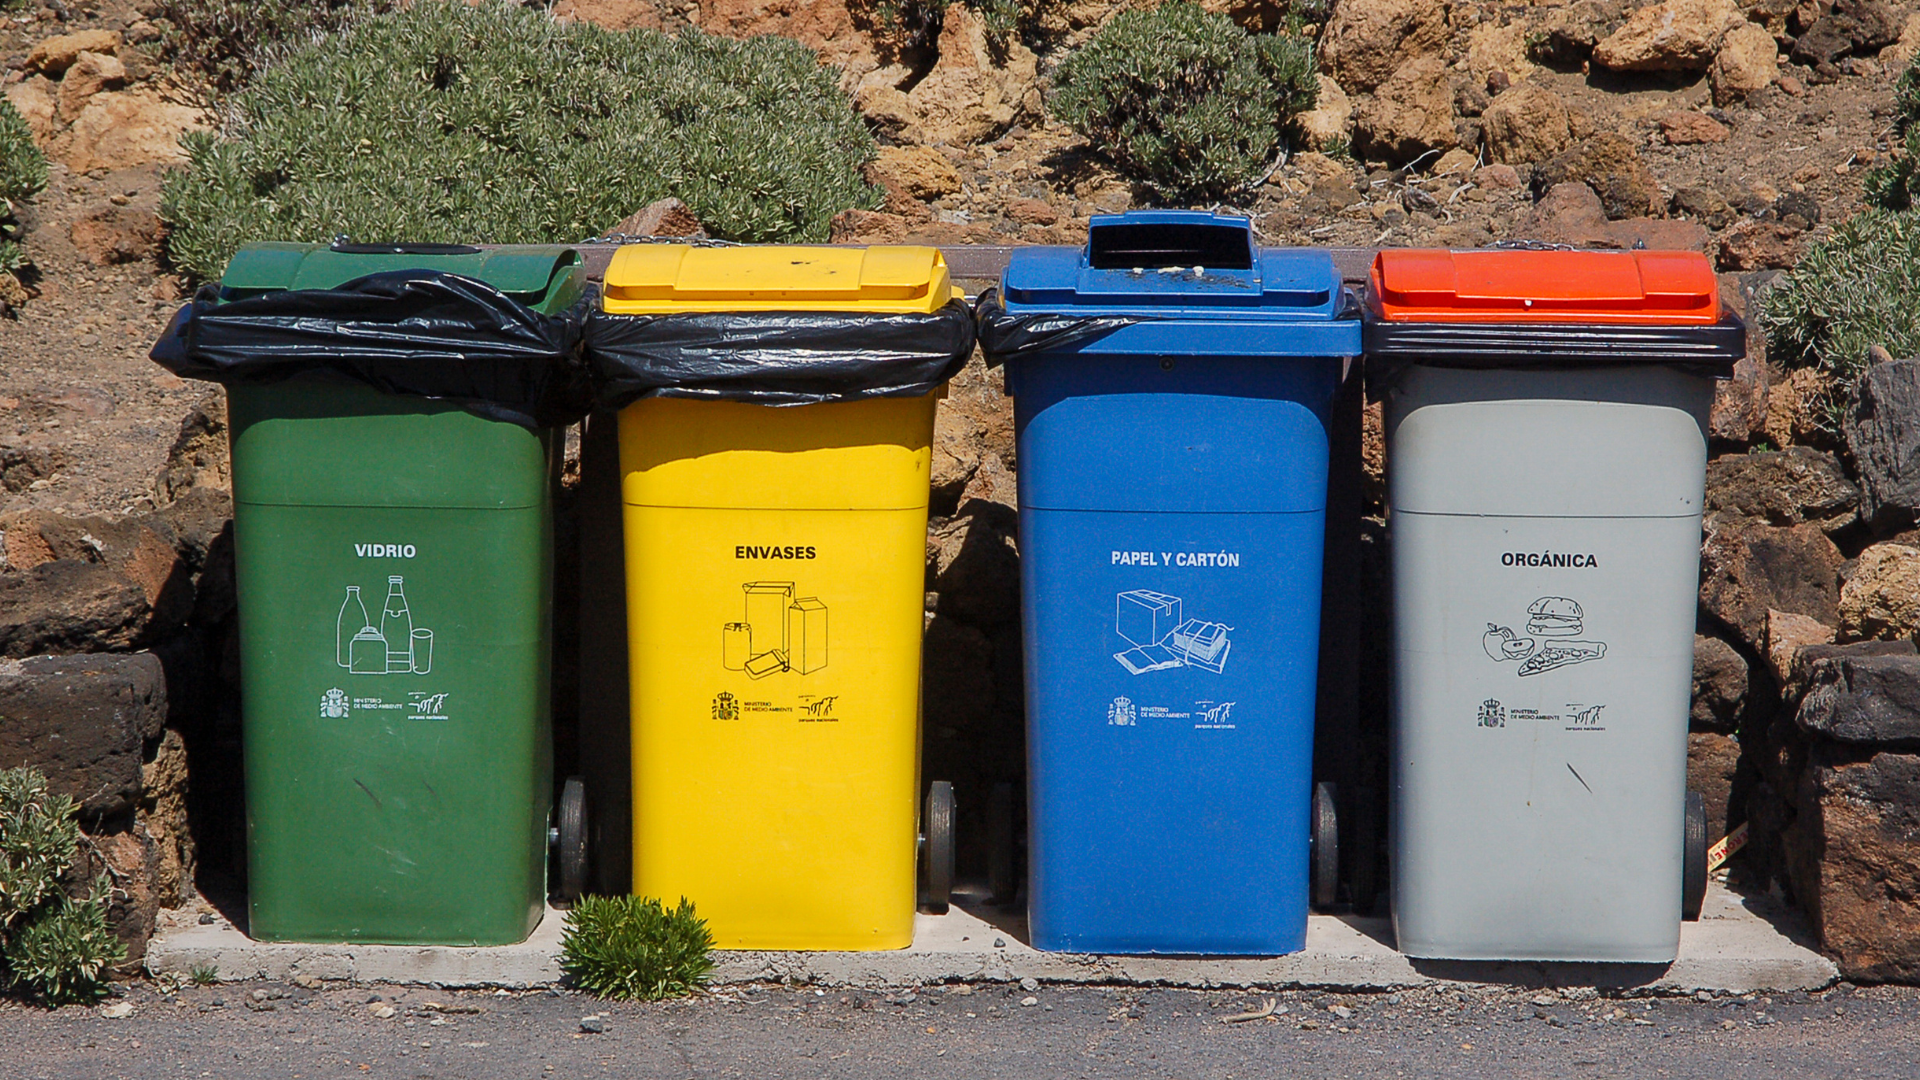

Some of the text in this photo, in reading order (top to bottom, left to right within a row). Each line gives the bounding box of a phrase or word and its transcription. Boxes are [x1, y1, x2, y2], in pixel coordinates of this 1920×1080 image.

[354, 543, 416, 558] VIDRIO
[735, 546, 816, 560] ENVASES
[1111, 549, 1240, 567] PAPEL Y CARTÓN
[1501, 549, 1598, 568] ORGÁNICA
[1715, 830, 1748, 860] ERONE
